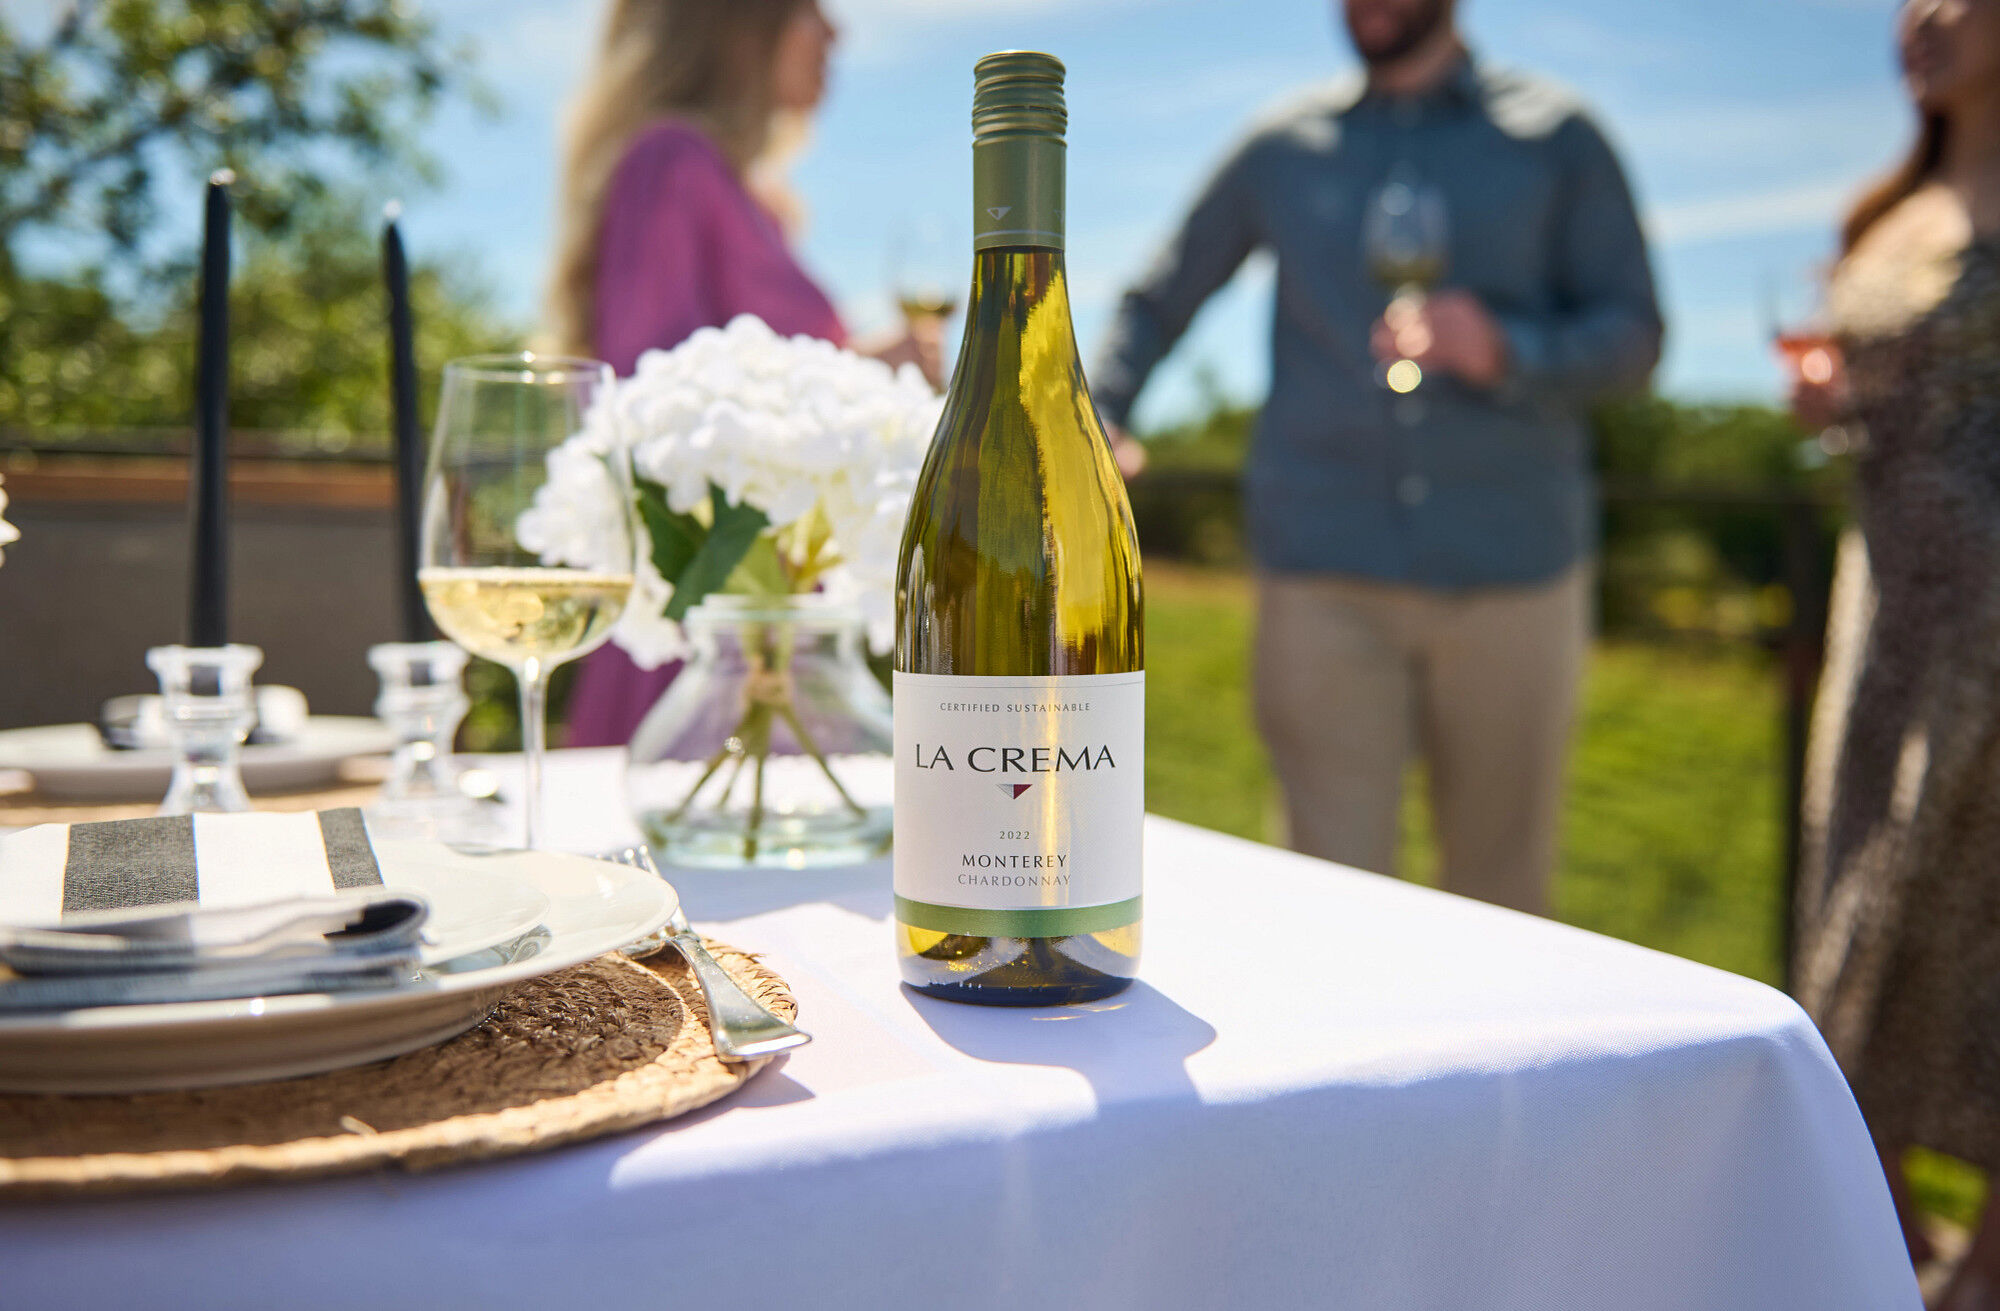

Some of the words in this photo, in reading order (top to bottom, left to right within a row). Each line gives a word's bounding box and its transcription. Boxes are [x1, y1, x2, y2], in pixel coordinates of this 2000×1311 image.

[940, 702, 1000, 713] CERTIFIED
[1007, 702, 1091, 713] SUSTAINABLE
[916, 743, 955, 771] LA
[967, 744, 1116, 773] CREMA
[999, 830, 1030, 840] 2022
[962, 854, 1067, 868] MONTEREY
[957, 873, 1071, 887] CHARDONNAY
